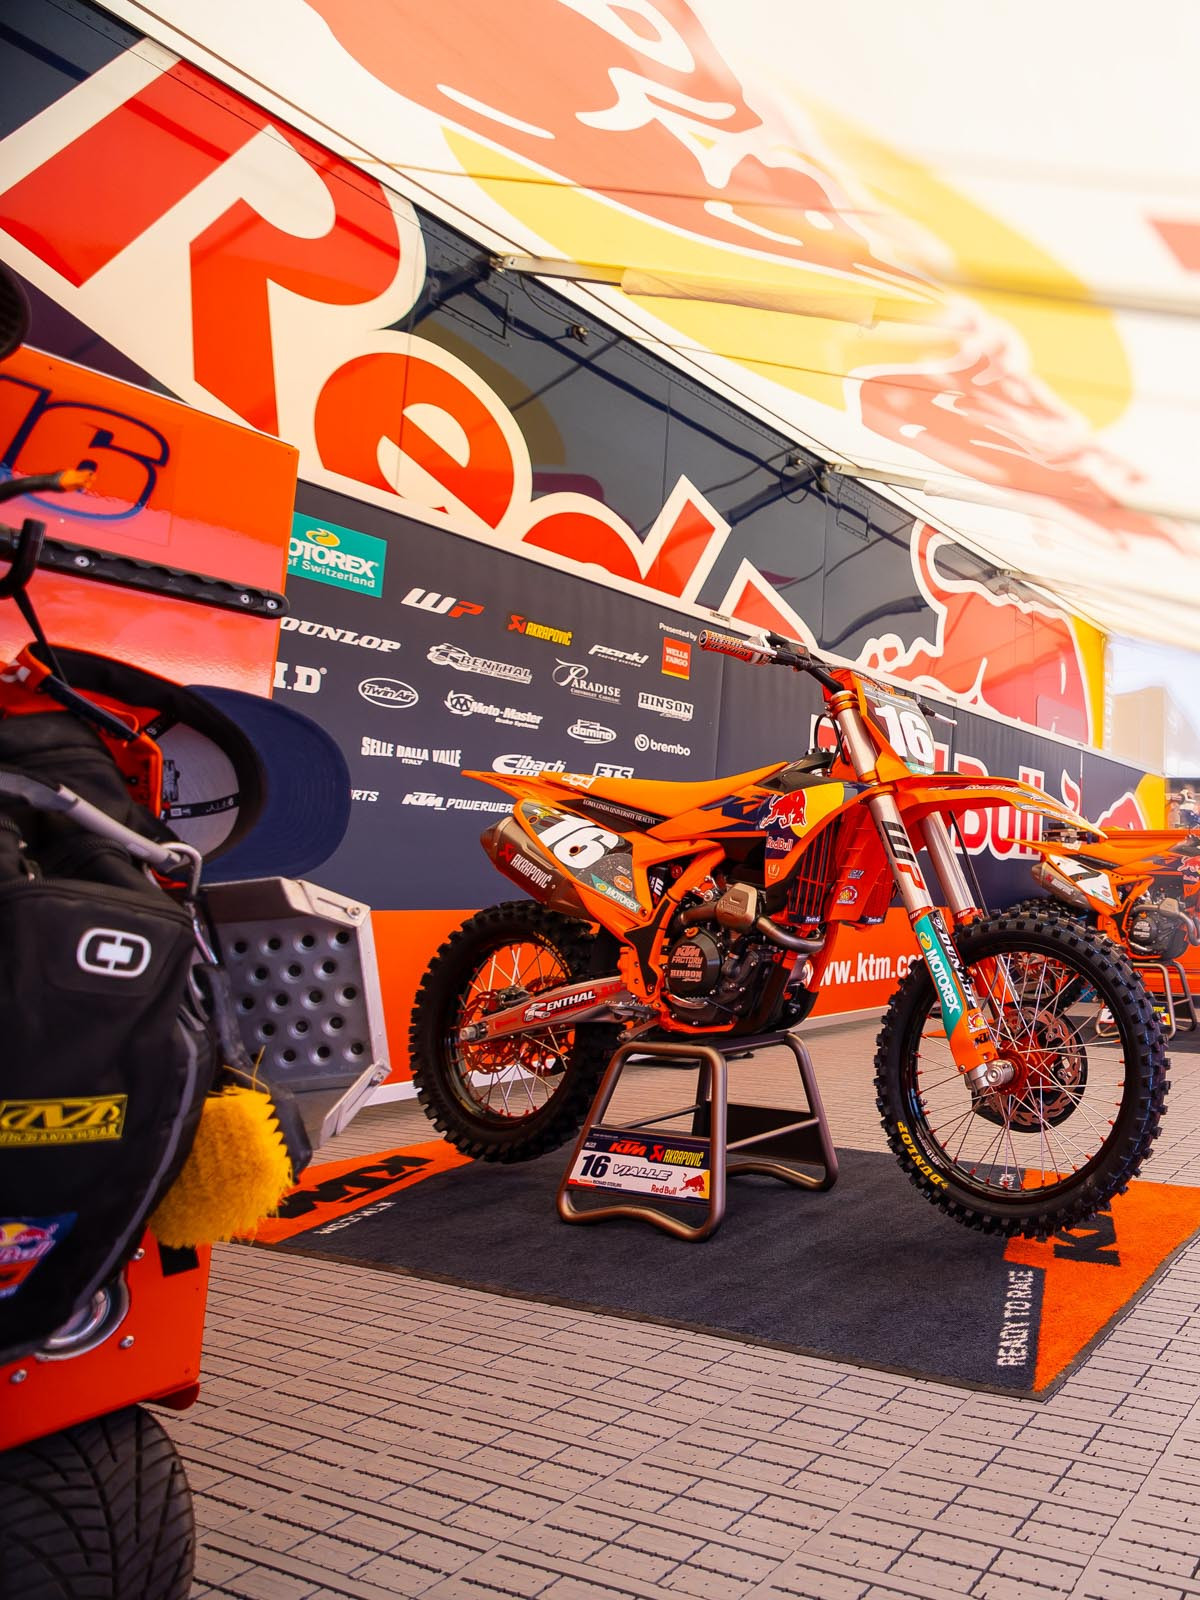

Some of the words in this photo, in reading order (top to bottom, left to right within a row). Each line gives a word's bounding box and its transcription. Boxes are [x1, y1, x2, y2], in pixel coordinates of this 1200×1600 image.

[288, 538, 375, 578] OTOREX
[302, 562, 376, 588] Switzerland
[401, 588, 485, 618] WP
[280, 616, 401, 653] DUNLOP
[659, 622, 688, 638] Presented
[689, 632, 698, 641] by
[588, 644, 650, 664] pankl
[665, 646, 689, 659] WELLS
[665, 655, 688, 667] FARGO
[640, 694, 693, 715] HINSON
[573, 725, 613, 741] domino
[875, 704, 935, 764] 16
[361, 736, 394, 757] SELLE
[396, 744, 429, 760] DALLA
[432, 749, 462, 767] VALLE
[650, 738, 691, 756] brembo
[538, 812, 619, 869] 16
[605, 886, 642, 912] MOTOREX
[671, 956, 703, 964] FACTORY
[925, 948, 960, 1014] MOTOREX
[608, 1140, 647, 1156] KTM
[898, 1121, 943, 1184] DUNLOP
[580, 1154, 611, 1178] 16
[613, 1164, 673, 1181] VIALLE
[1006, 1271, 1033, 1299] RACE
[1003, 1301, 1032, 1321] TO
[997, 1322, 1031, 1366] READY
